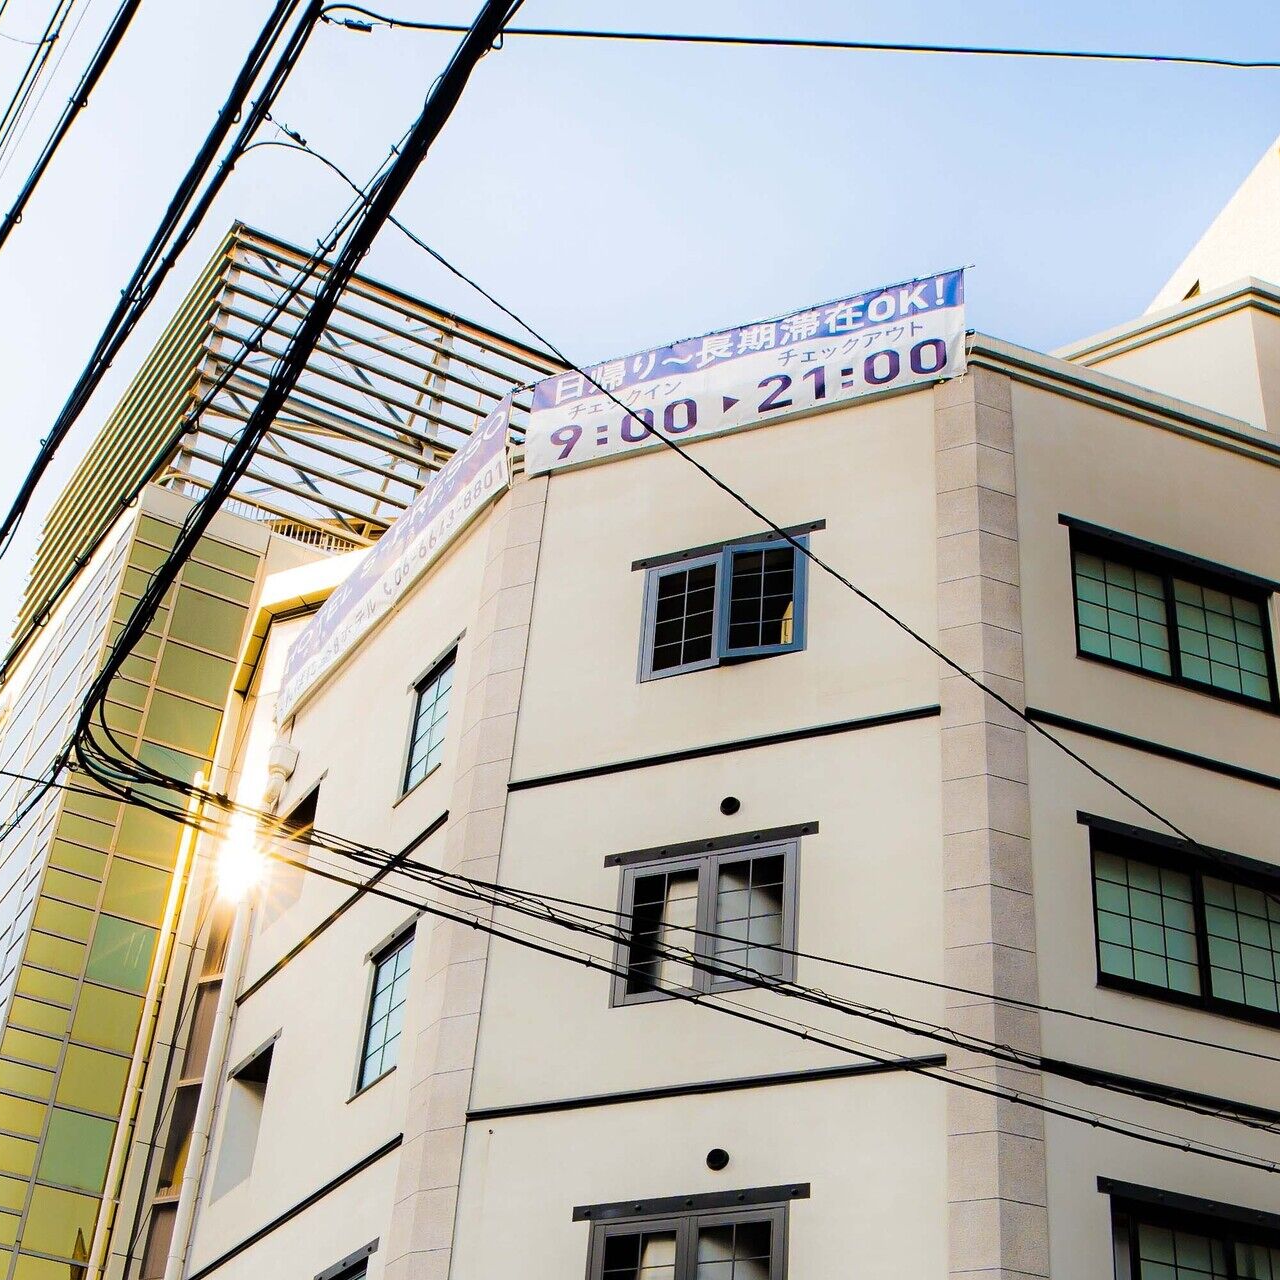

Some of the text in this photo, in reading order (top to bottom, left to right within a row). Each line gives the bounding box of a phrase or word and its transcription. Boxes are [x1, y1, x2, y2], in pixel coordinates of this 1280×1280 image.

[778, 320, 924, 367] チェックアウト
[549, 337, 948, 461] 9:00 21:00
[567, 378, 682, 421] チェックイン
